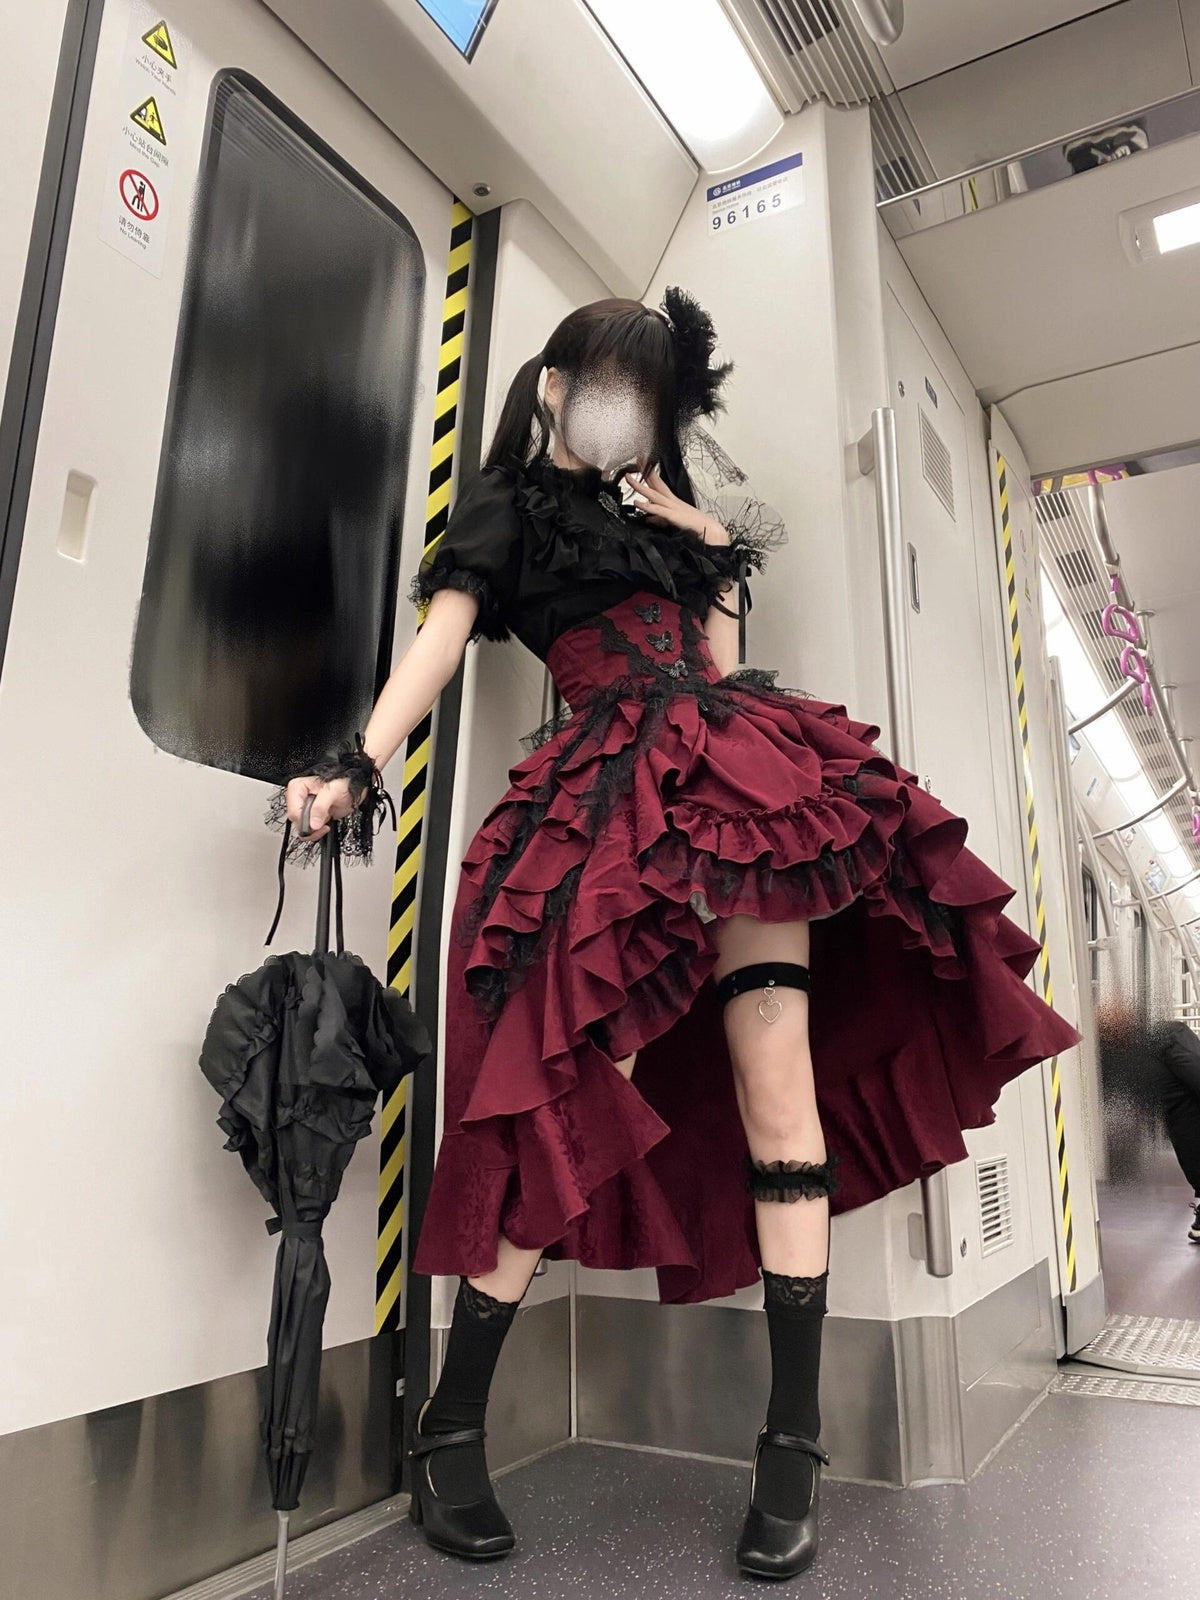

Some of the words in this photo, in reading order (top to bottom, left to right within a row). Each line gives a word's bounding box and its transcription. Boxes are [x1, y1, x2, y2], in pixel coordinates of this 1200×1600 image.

[142, 54, 171, 82] 小心夹手
[712, 193, 781, 230] 96165
[119, 215, 150, 244] 请勿倚靠
[120, 227, 127, 236] No
[127, 232, 147, 250] Leaning
